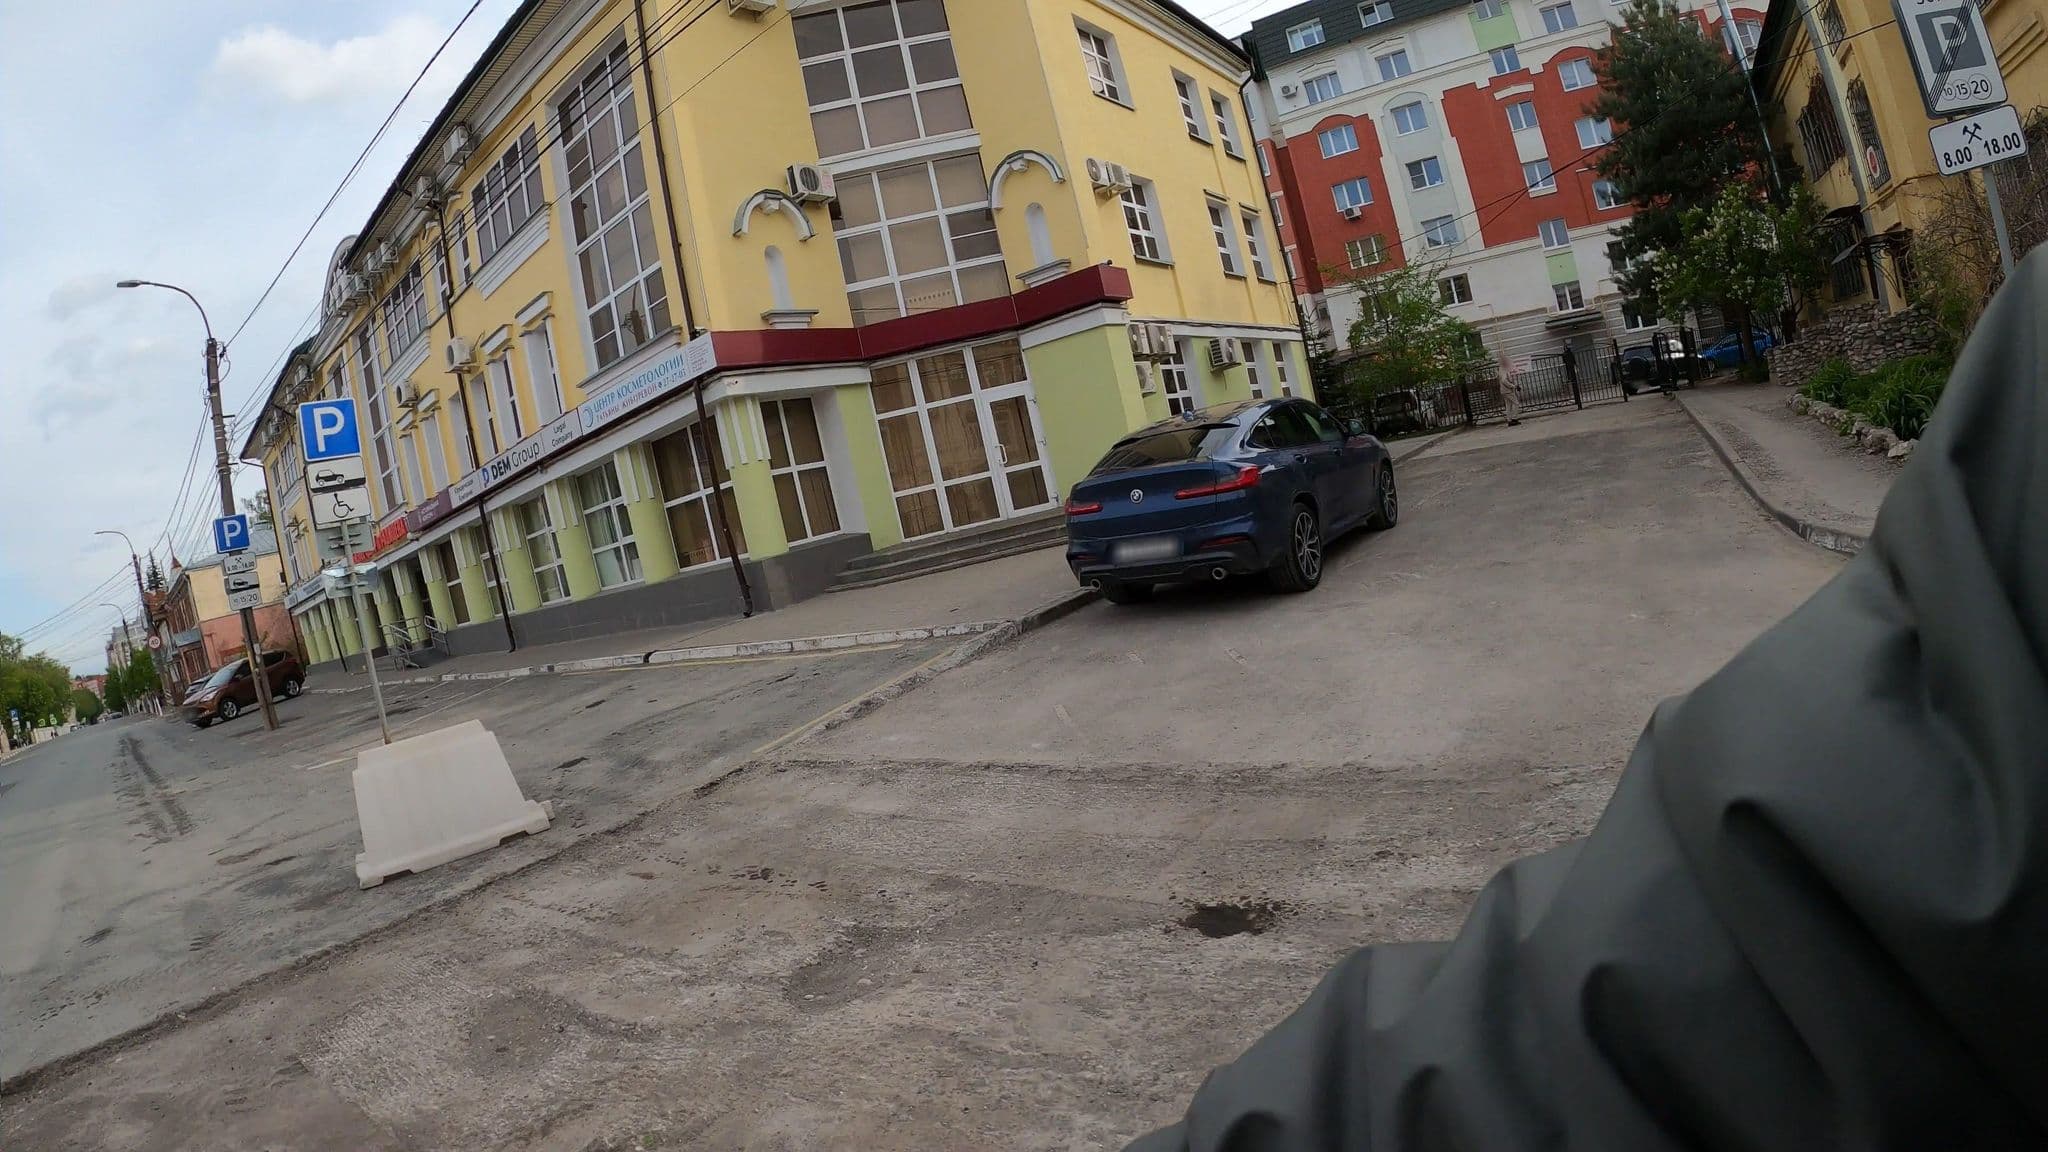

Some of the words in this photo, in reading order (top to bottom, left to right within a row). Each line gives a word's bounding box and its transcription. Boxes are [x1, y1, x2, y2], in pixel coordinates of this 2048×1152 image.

[1943, 87, 1953, 96] 10
[1956, 83, 1968, 96] 15
[1970, 79, 1989, 94] 20
[1943, 146, 1973, 168] 8.00
[1983, 132, 2021, 156] 18.00
[593, 391, 616, 413] ЦЕНТР
[617, 353, 684, 399] КОСМЕТОЛОГИИ
[312, 406, 345, 453] P
[551, 430, 574, 448] Company
[553, 420, 567, 435] Legal
[491, 456, 511, 480] DEM
[511, 442, 540, 467] Group
[222, 519, 242, 547] P
[246, 593, 258, 602] 20
